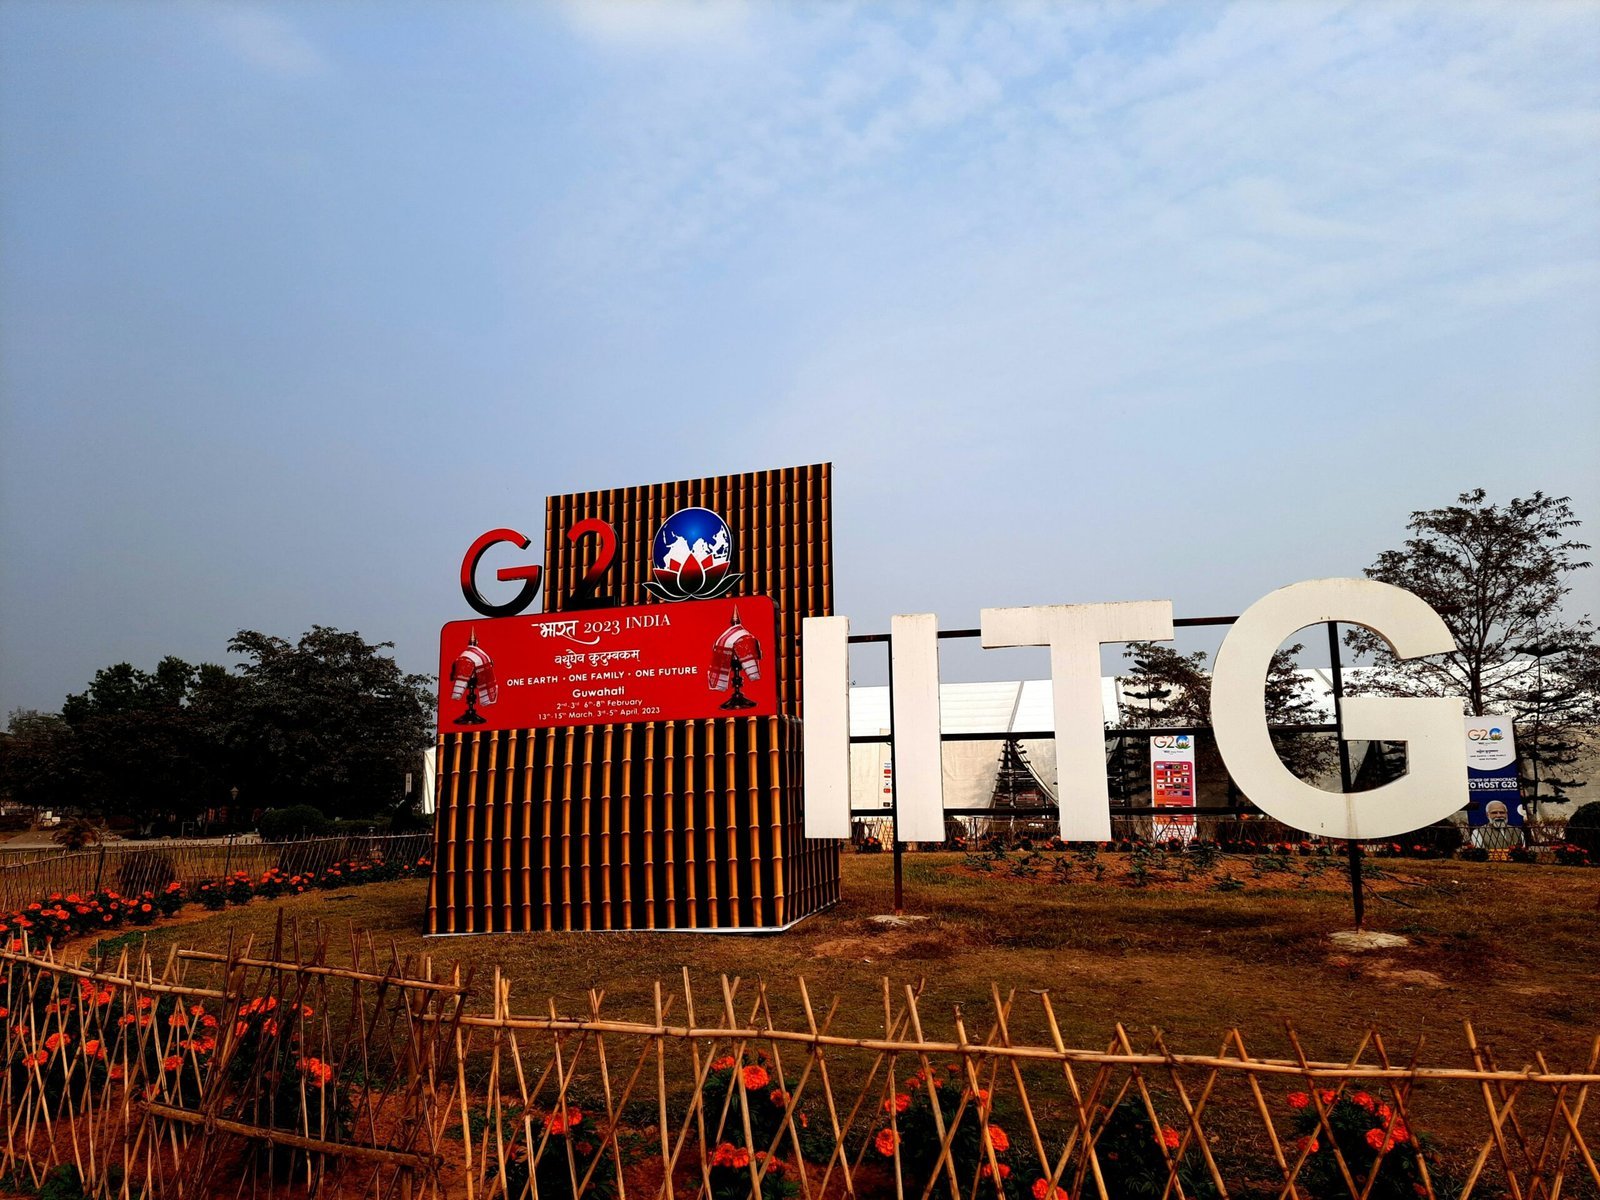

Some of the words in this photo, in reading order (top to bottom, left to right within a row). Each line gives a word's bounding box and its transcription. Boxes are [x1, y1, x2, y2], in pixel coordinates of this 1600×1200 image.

[583, 619, 620, 635] 2023
[625, 613, 671, 629] INDIA
[506, 678, 525, 687] ONE
[527, 675, 558, 685] EARTH
[568, 673, 587, 682] ONE
[590, 671, 625, 680] FAMILY
[635, 668, 655, 678] ONE
[658, 666, 698, 676] FUTURE
[572, 686, 625, 698] Guwahati
[607, 699, 643, 707] February
[641, 706, 661, 715] 2023
[802, 578, 1470, 842] IITG
[1477, 781, 1499, 789] HOST
